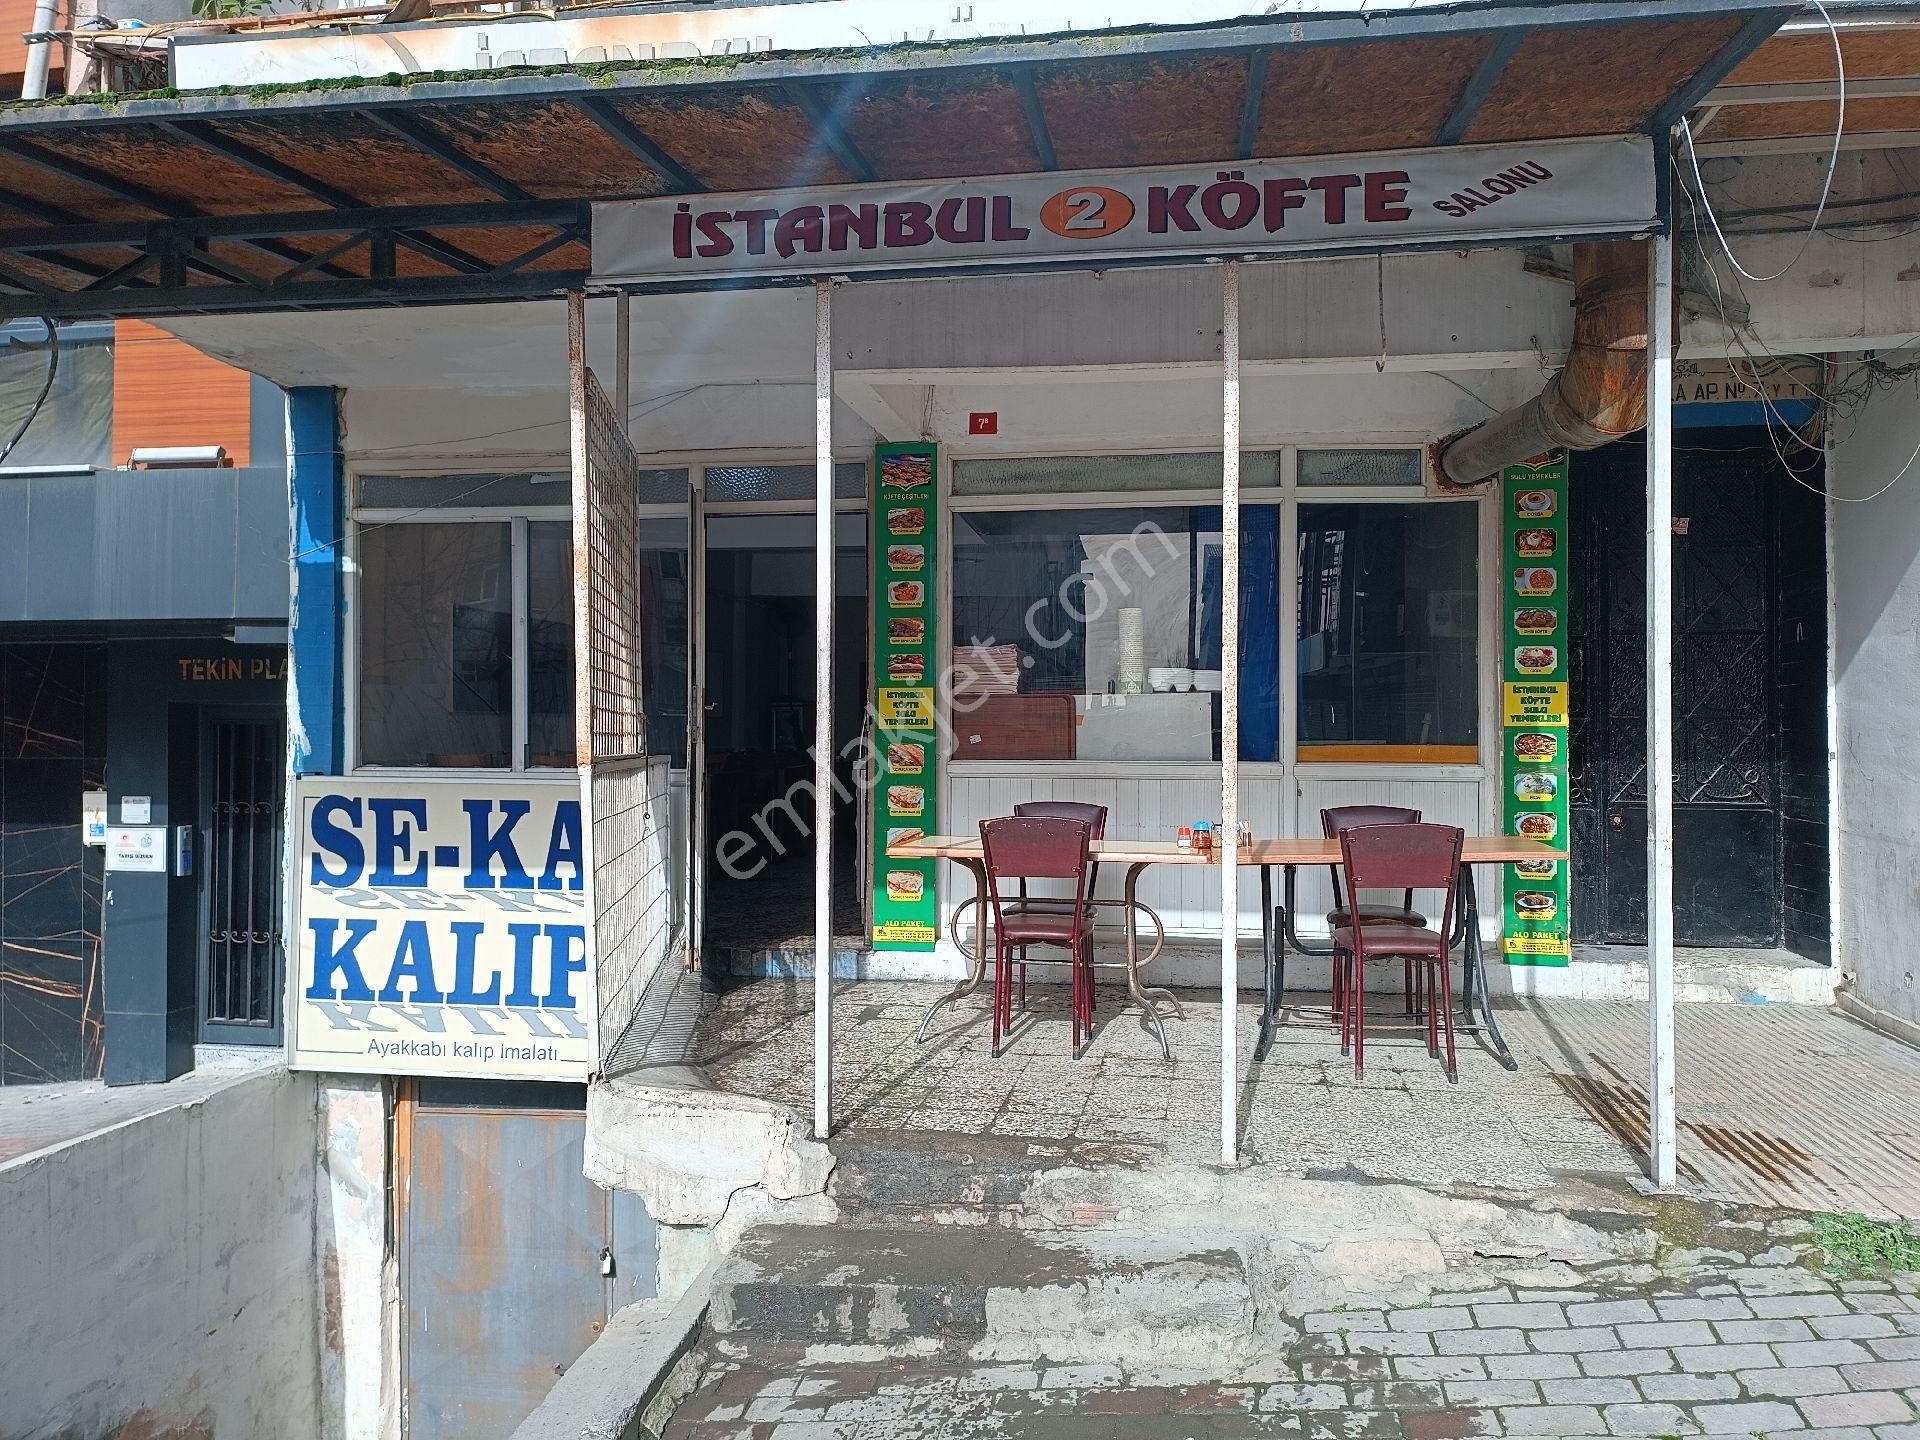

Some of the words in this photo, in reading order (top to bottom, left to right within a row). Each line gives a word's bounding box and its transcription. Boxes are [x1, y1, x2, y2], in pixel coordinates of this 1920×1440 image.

[673, 196, 1030, 259] İSTANBUL
[1067, 191, 1107, 231] 2
[1147, 169, 1413, 234] KÖFTE
[1432, 159, 1554, 219] SALONU
[178, 657, 242, 681] TEKİN
[310, 794, 583, 891] SE-KA
[305, 917, 587, 1009] KALIP
[1532, 931, 1560, 939] PAKET
[367, 1038, 447, 1059] Ayakkabı
[452, 1041, 495, 1062] kalıp
[500, 1043, 559, 1061] imalatı
